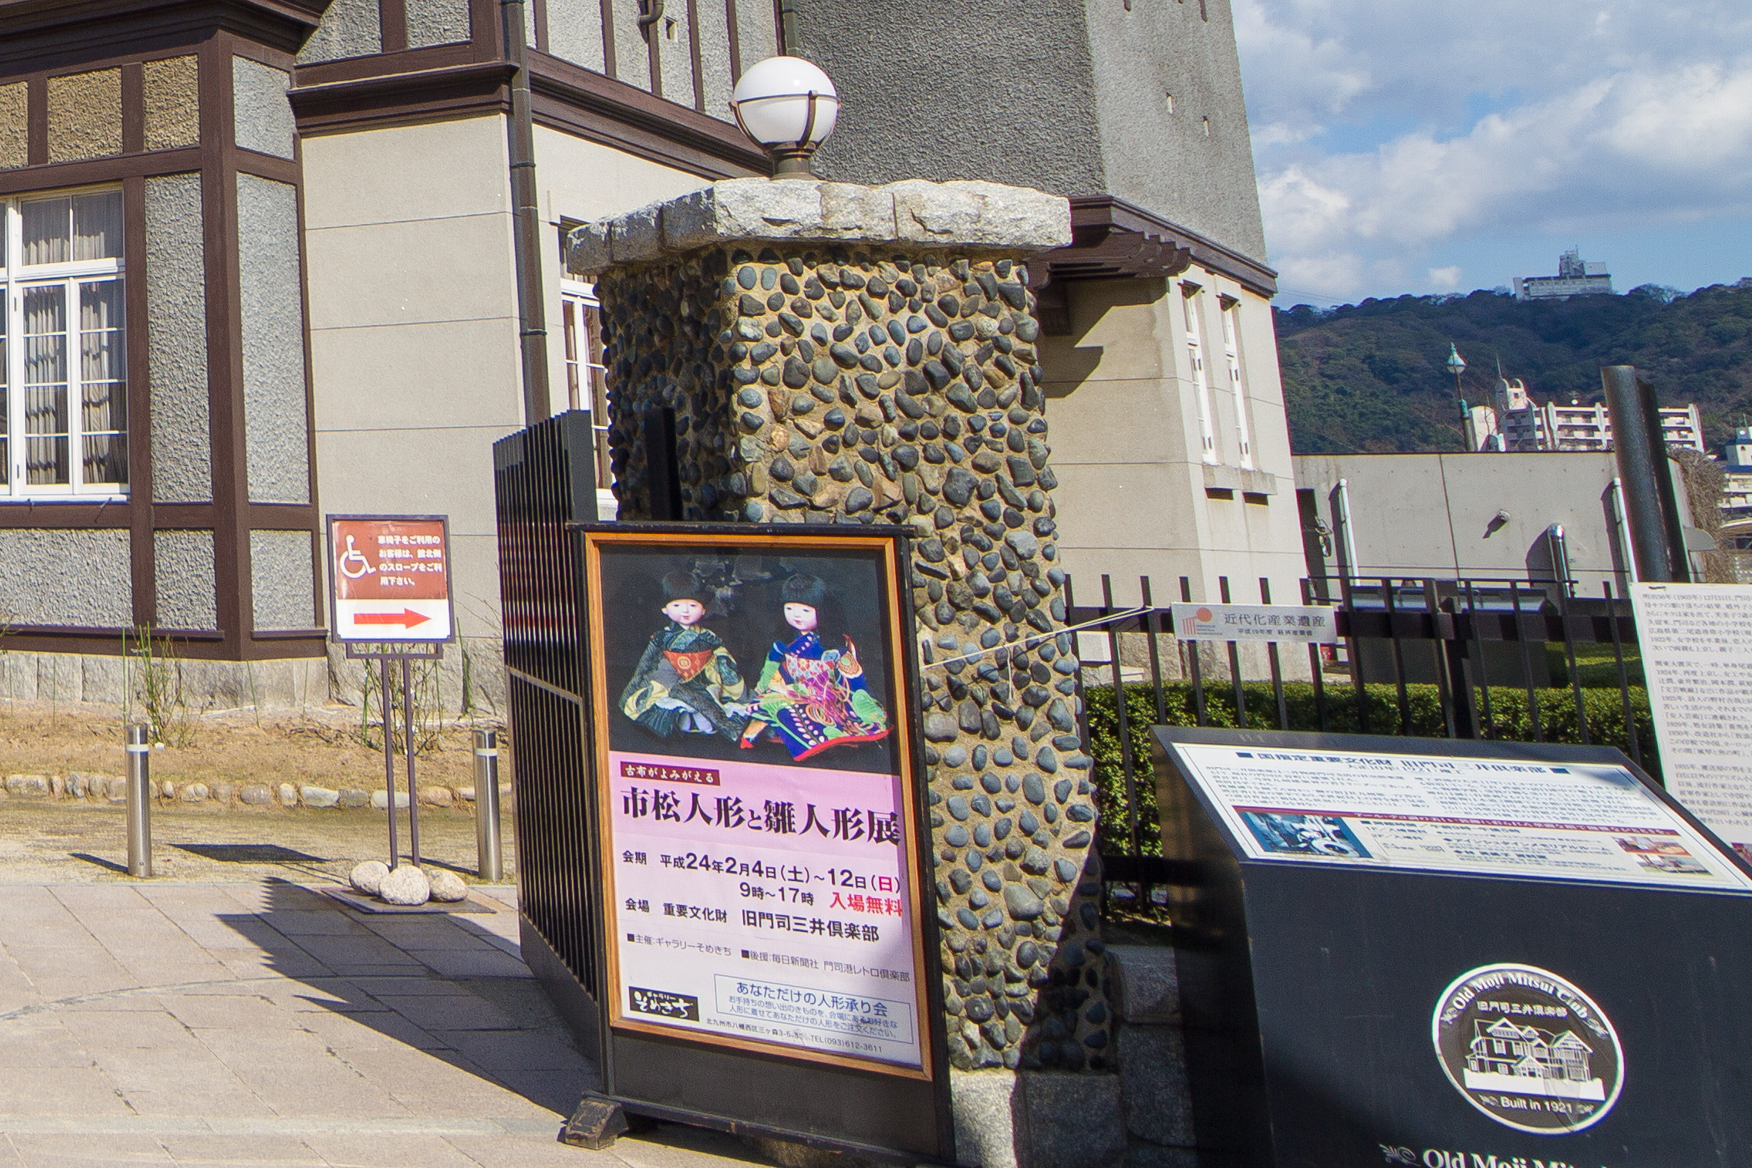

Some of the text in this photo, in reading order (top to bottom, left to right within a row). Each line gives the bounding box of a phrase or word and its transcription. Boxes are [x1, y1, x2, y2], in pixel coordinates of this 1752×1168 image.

[1224, 613, 1326, 627] 近代化産業遺産
[625, 764, 714, 783] 古布がよみがえる
[620, 786, 901, 846] 市松人形と雛人形展
[623, 850, 647, 865] 会期
[740, 882, 903, 917] 9時～17時 入場無料
[625, 898, 879, 943] 会場 重要文化財 旧門司三井倶楽部
[737, 982, 888, 1017] あなただけの人形承り会
[1452, 972, 1590, 1020] Old Moji Mitsui Club
[1500, 1096, 1573, 1114] Built in 1921
[1423, 1148, 1466, 1168] Old
